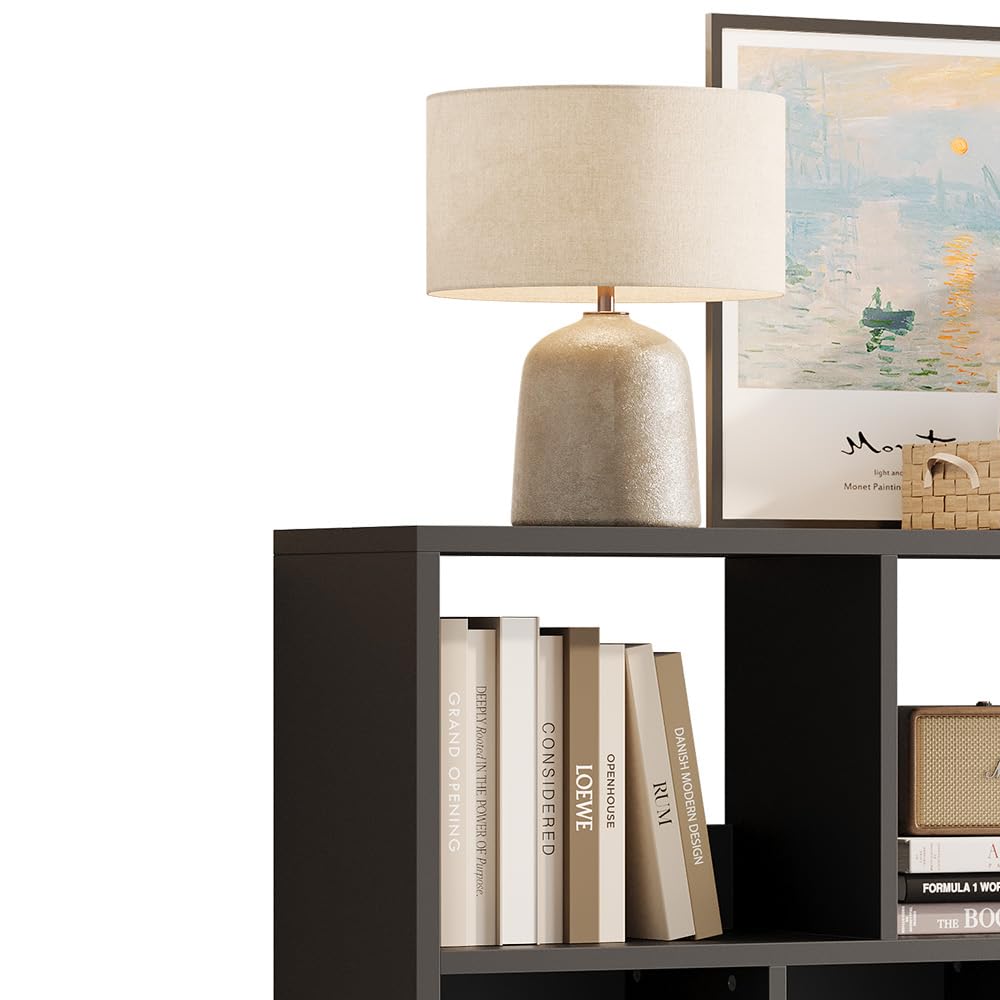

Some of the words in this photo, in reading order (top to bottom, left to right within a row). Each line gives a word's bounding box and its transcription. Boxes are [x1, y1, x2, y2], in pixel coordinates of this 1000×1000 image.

[844, 482, 871, 490] Monet
[874, 468, 890, 477] light
[448, 692, 461, 757] GRAND
[476, 686, 487, 724] DEEPLY
[476, 727, 487, 761] Rooted
[674, 727, 690, 772] DANISH
[476, 762, 487, 772] IN
[476, 776, 487, 796] THE
[541, 722, 555, 856] CONSIDERED
[576, 764, 593, 832] LOEWE
[606, 754, 615, 829] OPENHOUSE
[653, 781, 673, 827] RUM
[682, 773, 698, 823] MODERN
[448, 767, 461, 853] OPENING
[476, 799, 487, 837] POWER
[476, 839, 487, 854] OF
[689, 824, 704, 866] DESIGN
[476, 857, 487, 897] Purpose.
[923, 882, 970, 893] FORMULA
[972, 882, 977, 892] 1
[937, 919, 960, 929] THE
